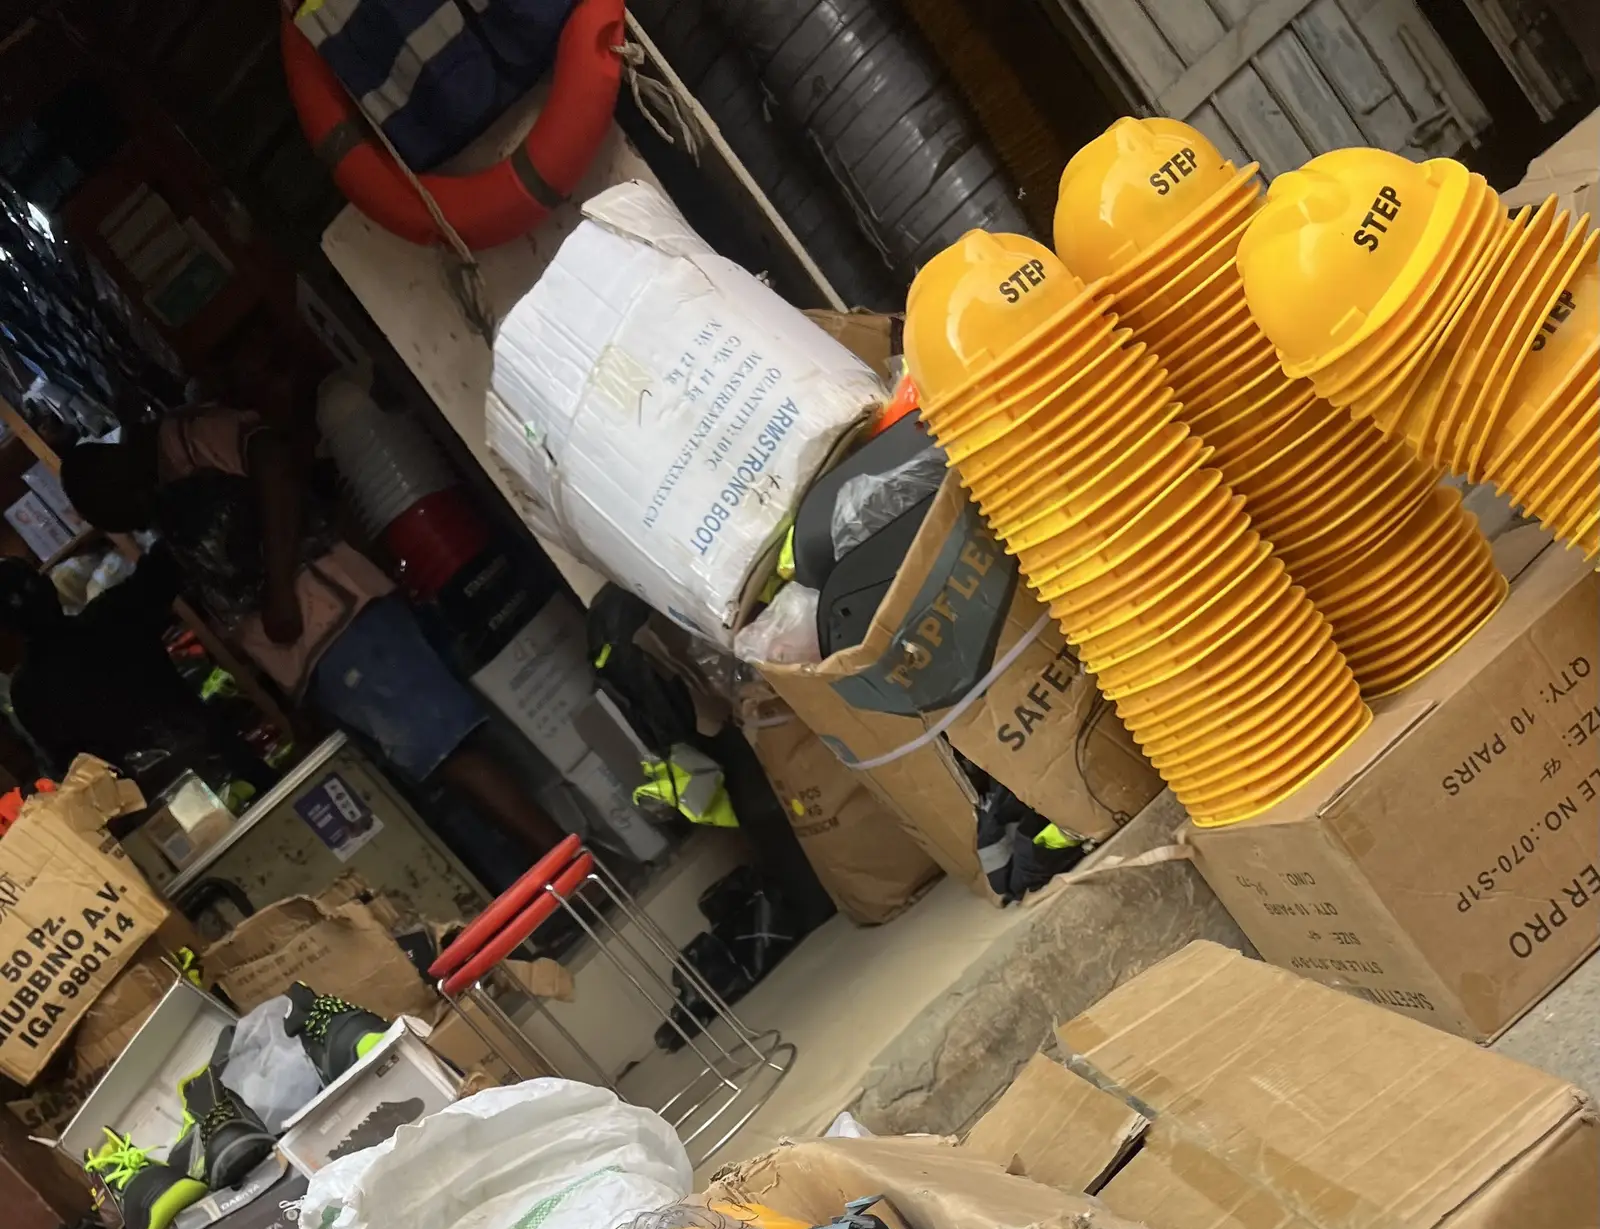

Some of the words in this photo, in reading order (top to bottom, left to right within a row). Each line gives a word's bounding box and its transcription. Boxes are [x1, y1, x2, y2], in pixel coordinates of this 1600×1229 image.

[1149, 147, 1198, 196] STEP
[1353, 185, 1402, 252] STEP
[999, 258, 1046, 304] STEP
[725, 366, 782, 438] QUANTITY:
[716, 436, 733, 454] 10
[720, 396, 801, 507] ARMSTRONG
[689, 501, 731, 556] BOOT
[884, 529, 998, 689] TOPFLE
[997, 645, 1083, 752] SAFET
[1539, 656, 1591, 704] QTY:
[1510, 707, 1535, 735] 10
[1442, 732, 1507, 796] PAIRS
[81, 881, 128, 931] A.V.
[1561, 864, 1600, 908] ER
[1, 949, 33, 983] 50
[26, 916, 66, 950] Pz.
[1509, 898, 1568, 958] PRO
[19, 1001, 66, 1049] IGA
[58, 912, 135, 999] 980114
[1349, 959, 1384, 975] STYLE
[219, 1182, 261, 1211] DAERTA
